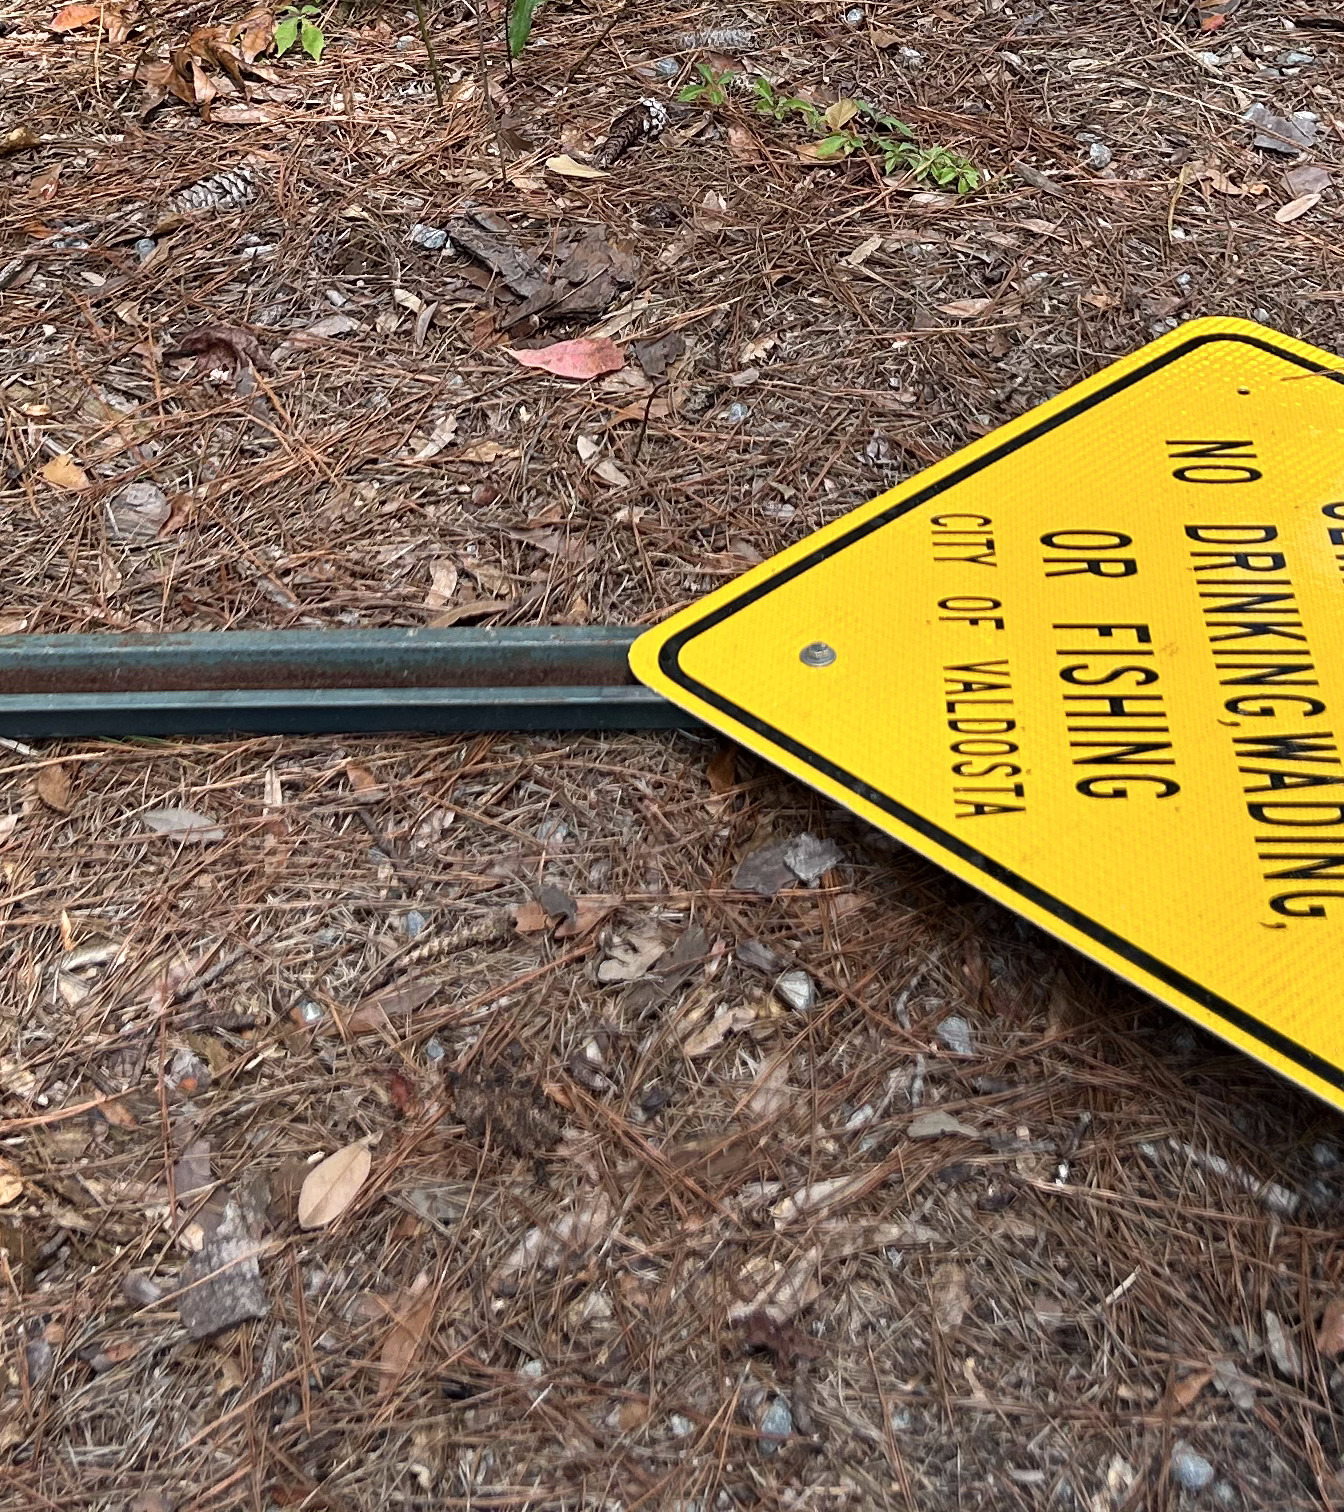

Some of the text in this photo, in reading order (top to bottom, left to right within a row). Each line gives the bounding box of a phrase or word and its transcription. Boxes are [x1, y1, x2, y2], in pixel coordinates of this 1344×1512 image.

[1165, 439, 1263, 484] NO
[929, 512, 1027, 819] CITY OF VALDOSTA
[1039, 529, 1182, 800] OR FISHING
